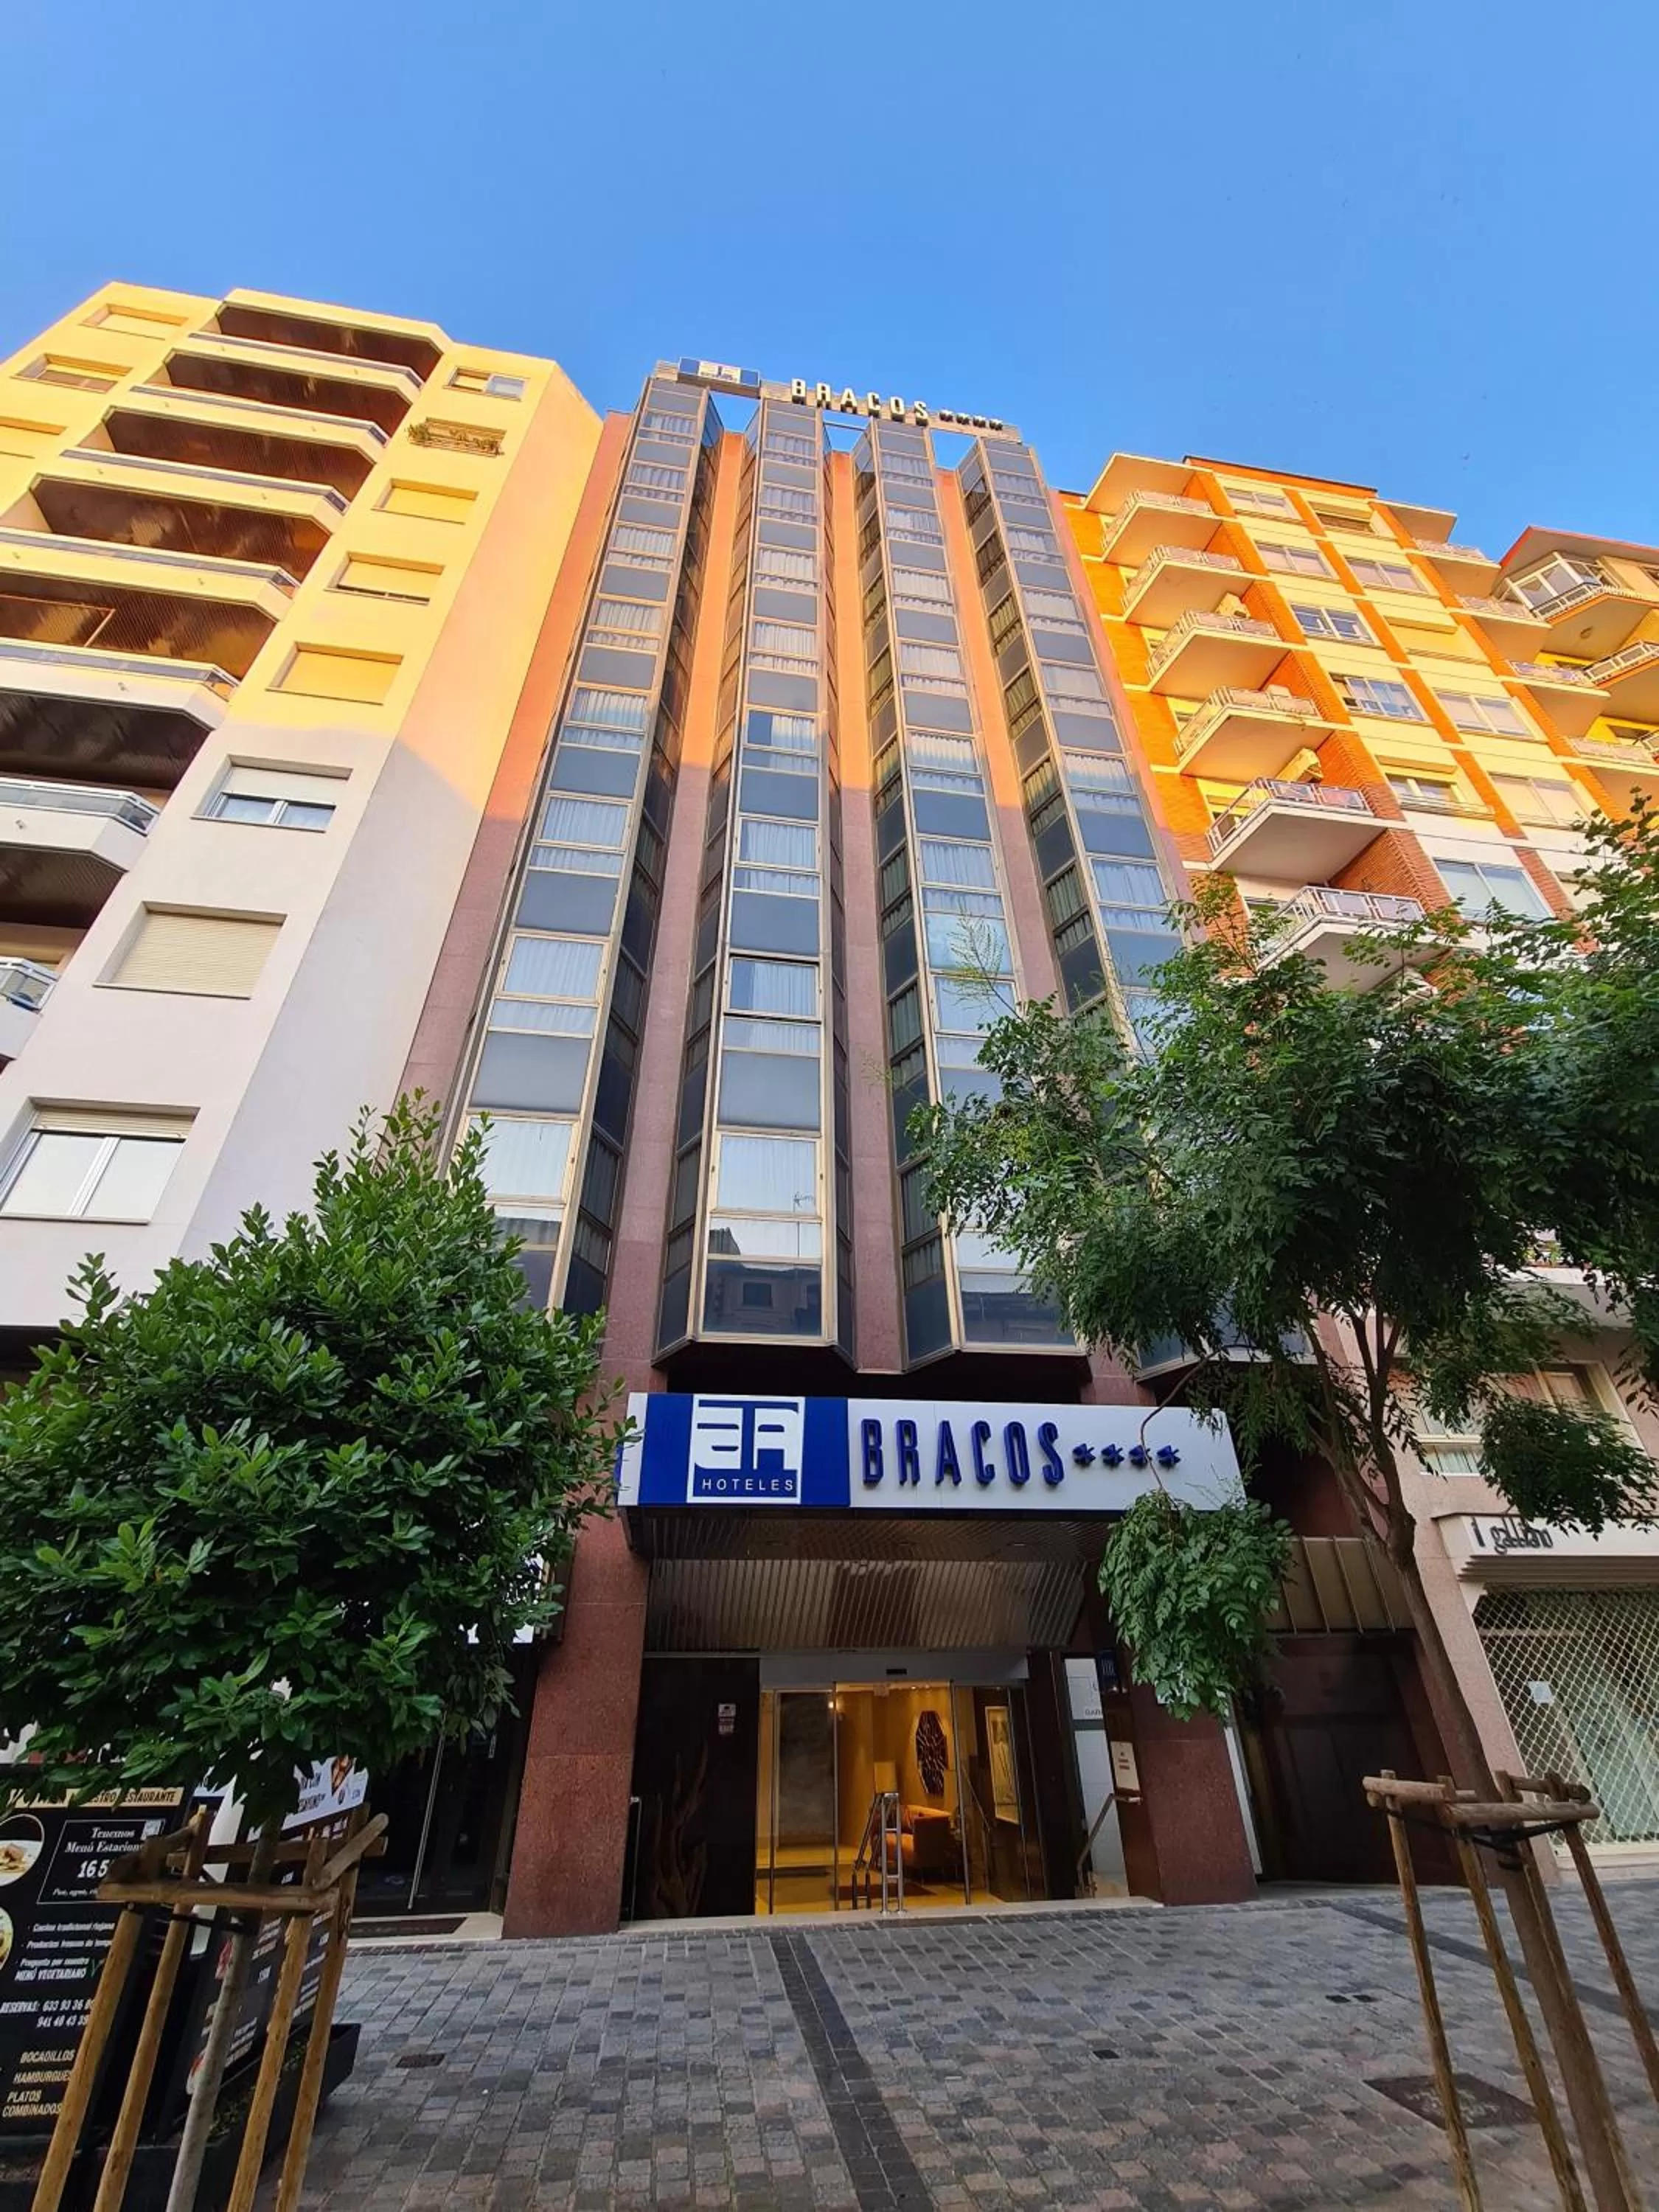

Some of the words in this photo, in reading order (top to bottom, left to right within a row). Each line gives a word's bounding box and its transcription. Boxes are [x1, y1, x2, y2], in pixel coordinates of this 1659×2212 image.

[791, 378, 929, 425] BRACOS
[860, 1419, 1065, 1486] BRACOS
[702, 1478, 793, 1491] HOTELES
[91, 1827, 135, 1839] Tenemos
[65, 1841, 94, 1853] Menú
[20, 2049, 75, 2063] BOCADILLOS
[7, 2090, 41, 2104] PLATOS
